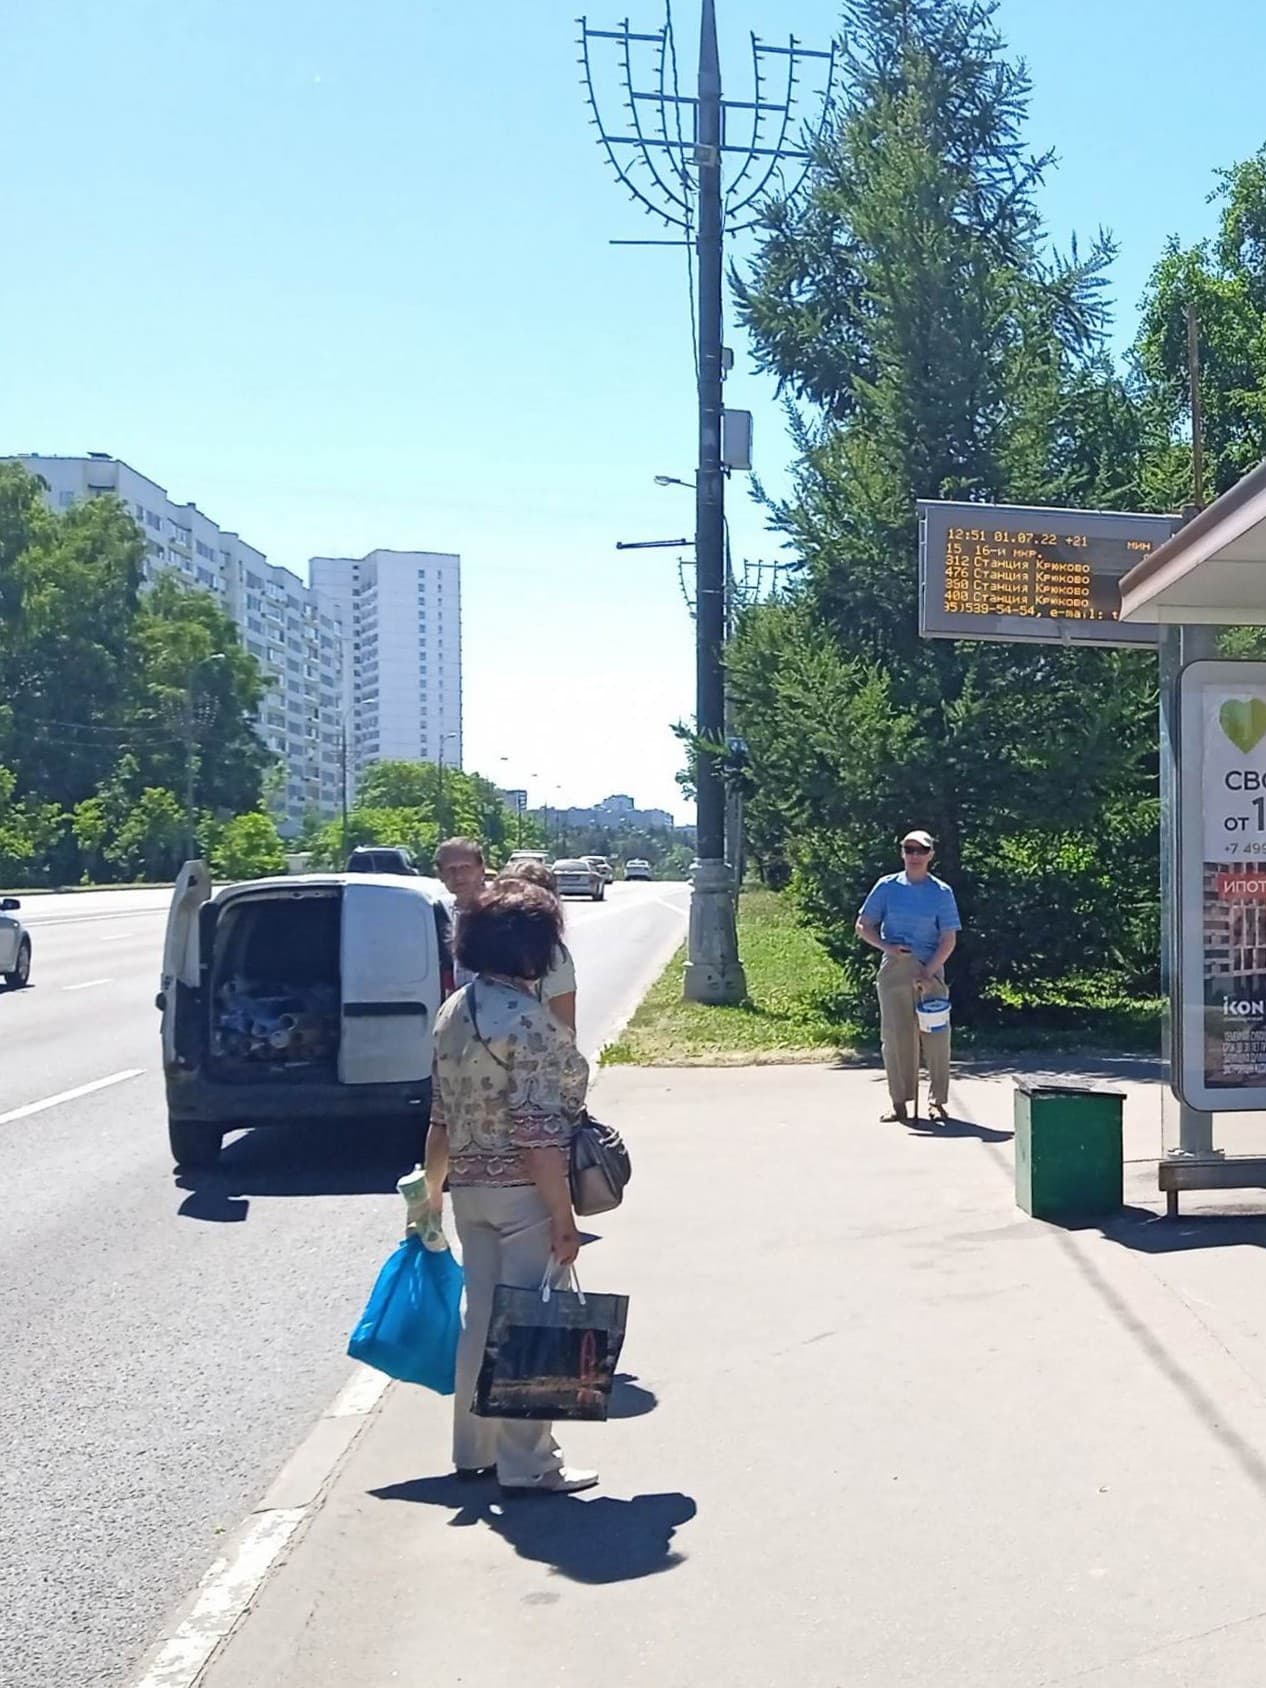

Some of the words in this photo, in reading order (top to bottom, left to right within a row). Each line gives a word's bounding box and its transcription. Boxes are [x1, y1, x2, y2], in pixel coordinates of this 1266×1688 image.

[947, 528, 986, 542] 12:51
[994, 530, 1057, 546] 01.07.22
[1065, 535, 1088, 547] +21
[946, 542, 962, 554] 15
[945, 555, 970, 567] 312
[973, 556, 1029, 569] Станция
[1035, 560, 1090, 573] Крюково
[945, 566, 969, 578] 476
[973, 567, 1029, 581] Станция
[1035, 571, 1090, 584] Крюково
[973, 579, 1028, 593] Станция
[1035, 583, 1090, 596] Крюково
[973, 591, 1028, 604] Станция
[1035, 594, 1090, 607] Крюково
[1224, 843, 1238, 855] +7
